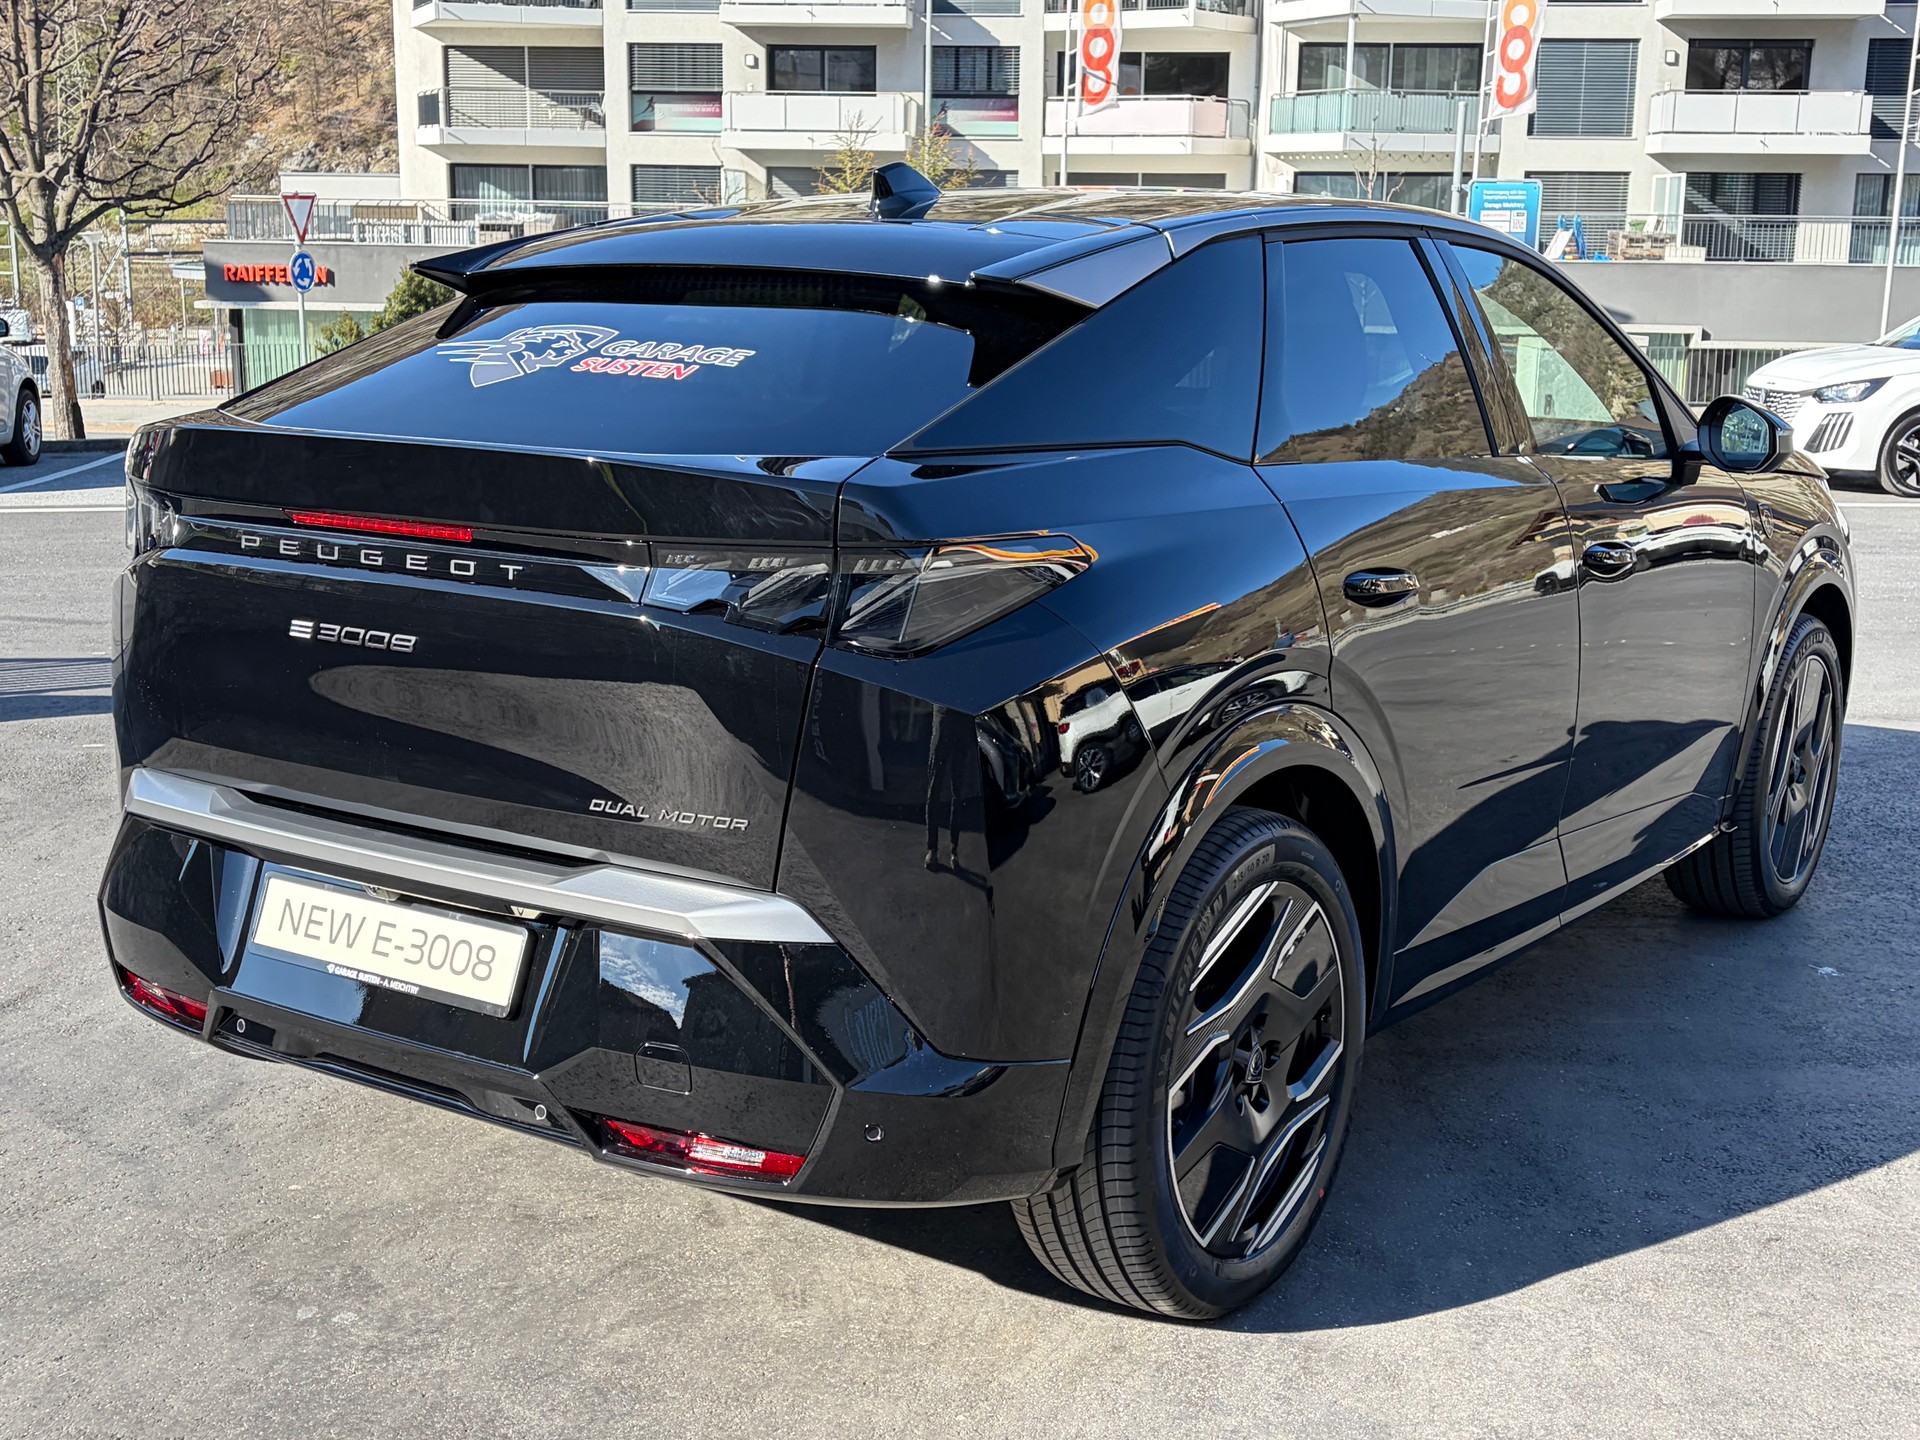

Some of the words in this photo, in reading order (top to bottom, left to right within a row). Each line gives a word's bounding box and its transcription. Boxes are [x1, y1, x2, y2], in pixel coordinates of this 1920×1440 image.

[223, 263, 328, 283] RAIFFEIN
[600, 340, 756, 367] GARAGE
[570, 357, 700, 381] SUSTEN
[240, 533, 524, 581] PEUGEOT
[588, 799, 650, 818] DUAL
[658, 809, 750, 831] MOTOR
[277, 898, 366, 949] NEW
[371, 920, 496, 982] E-3008
[335, 967, 358, 979] GARAGE
